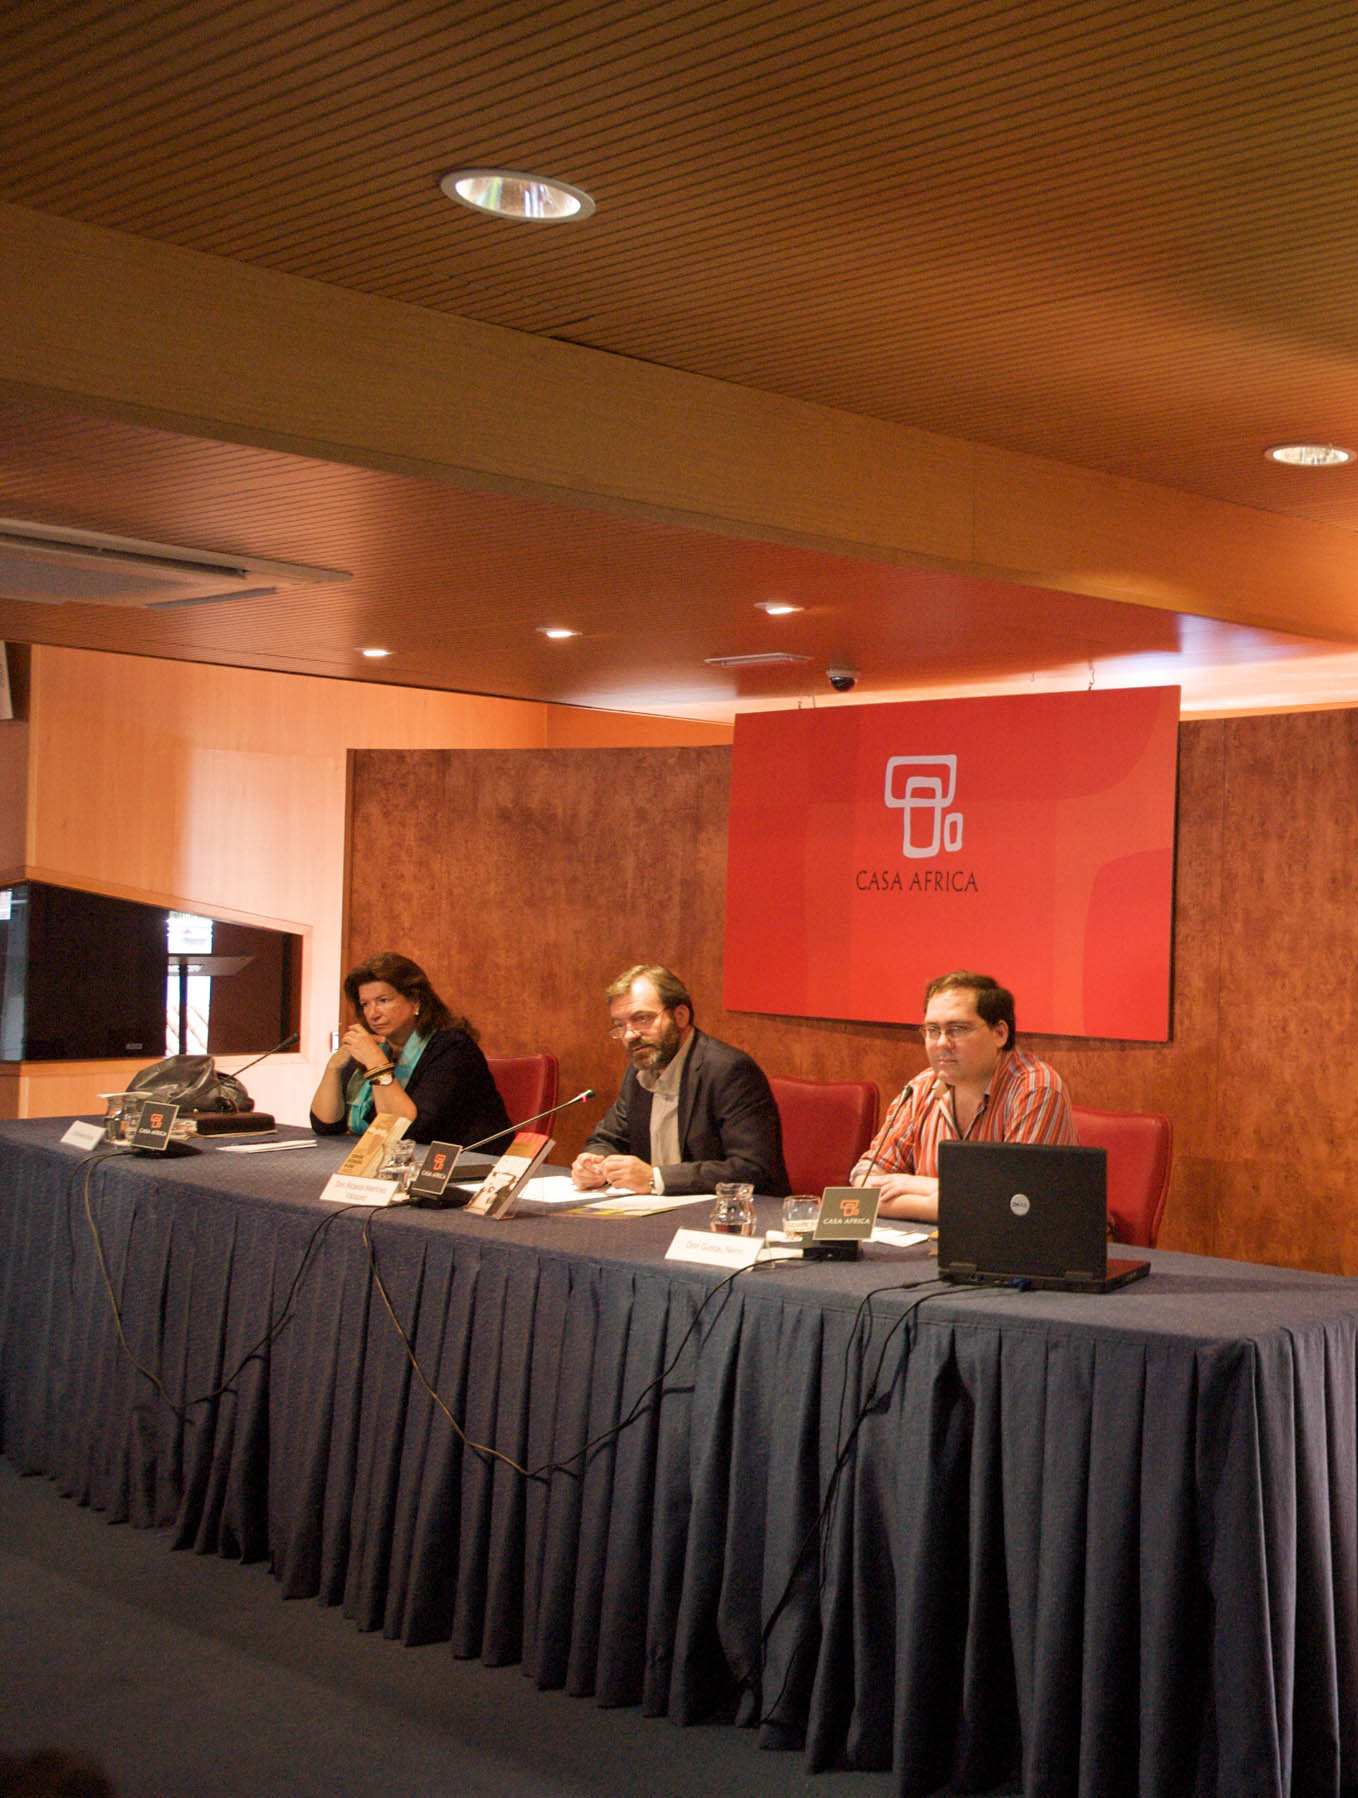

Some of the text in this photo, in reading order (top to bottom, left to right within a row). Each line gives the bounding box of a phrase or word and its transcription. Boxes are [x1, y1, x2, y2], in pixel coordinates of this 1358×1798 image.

[855, 870, 978, 893] CASA AFRICA
[823, 1217, 871, 1225] CASA AFRICA
